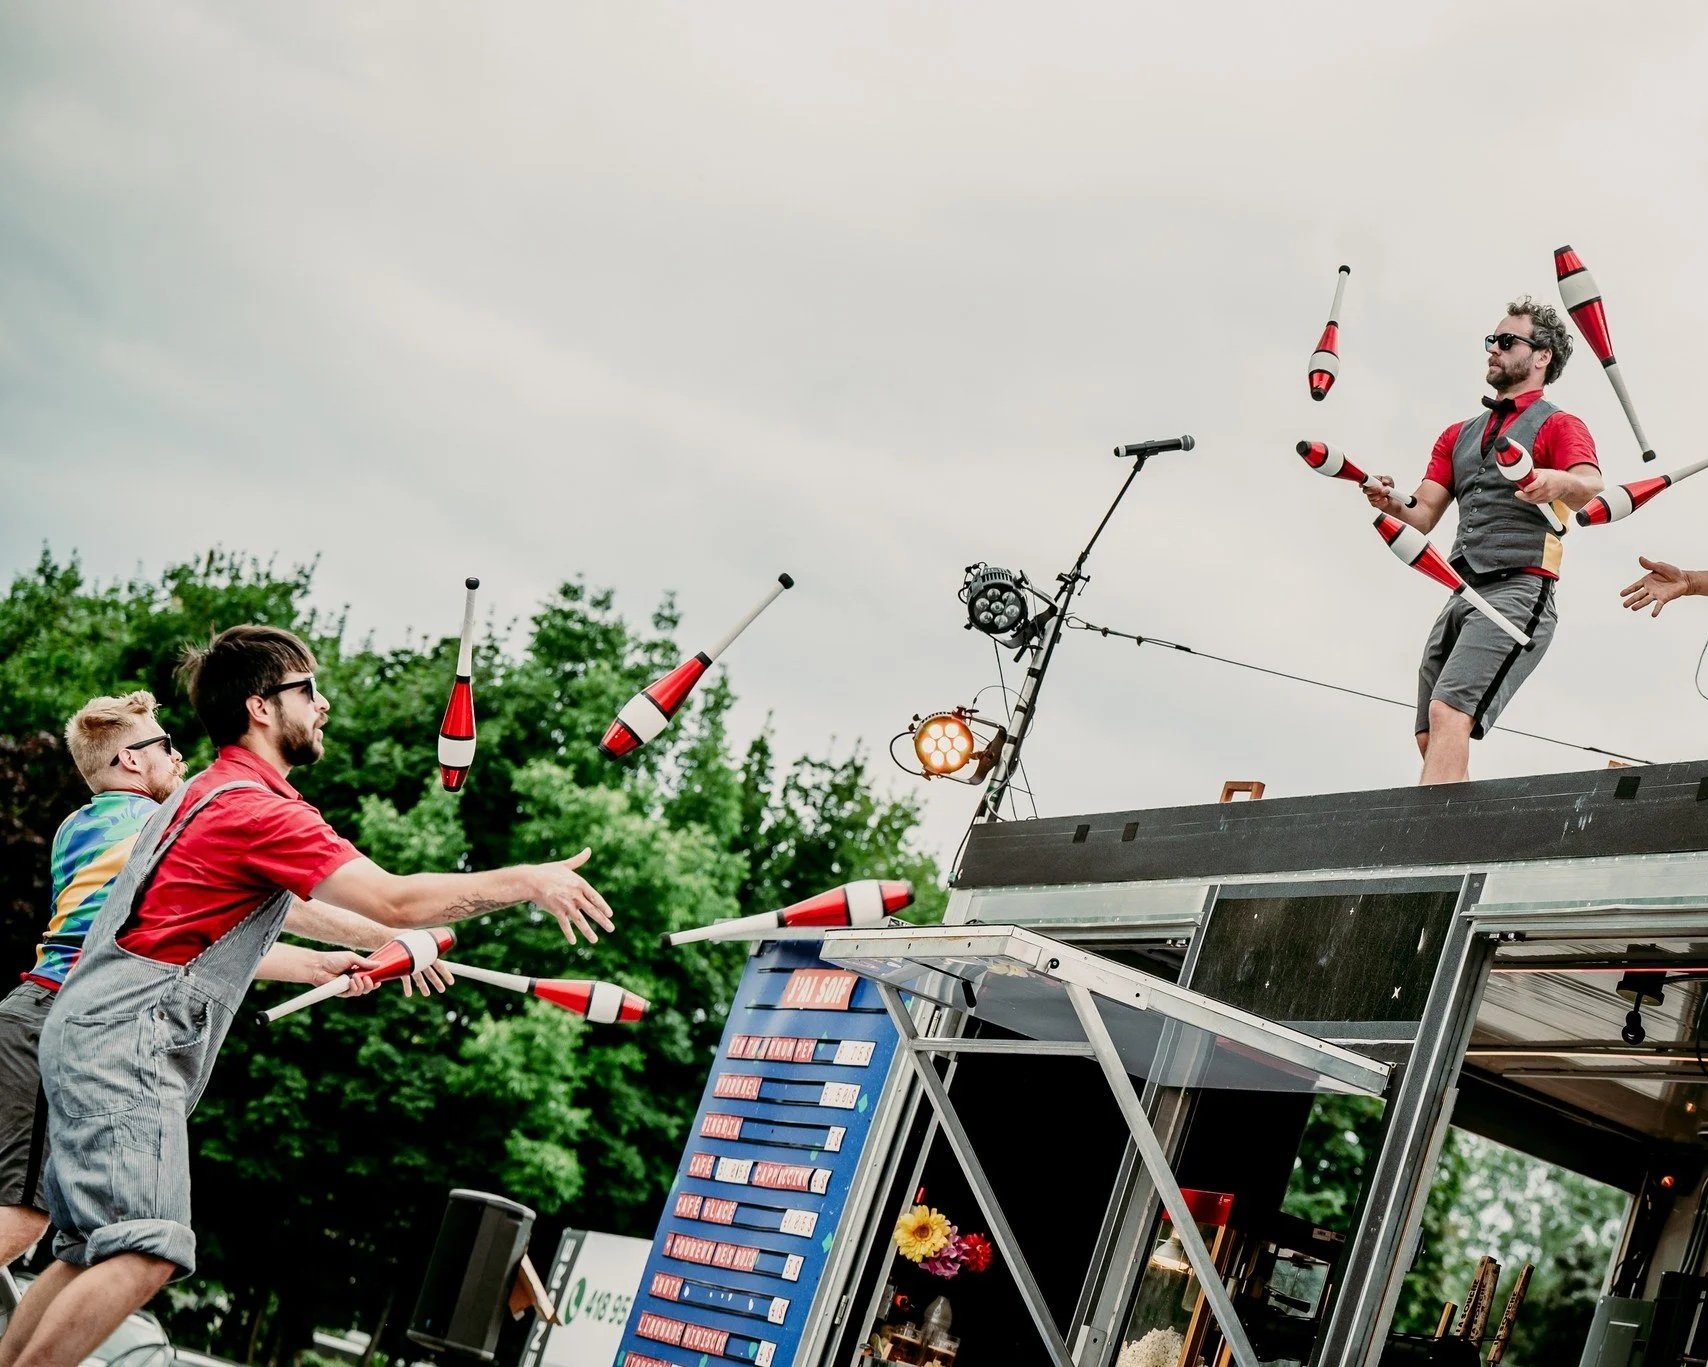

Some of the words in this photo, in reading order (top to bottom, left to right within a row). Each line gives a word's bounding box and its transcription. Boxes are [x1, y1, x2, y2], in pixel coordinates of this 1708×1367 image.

[787, 976, 818, 1002] J'AI
[815, 976, 852, 1004] SOIF
[714, 1245, 736, 1265] DES
[652, 1276, 681, 1298] SHOTS
[1461, 1279, 1479, 1318] SOUCHE
[586, 1291, 611, 1320] 418
[637, 1316, 684, 1341] LIMONADE
[685, 1327, 727, 1352] HIBISCUS
